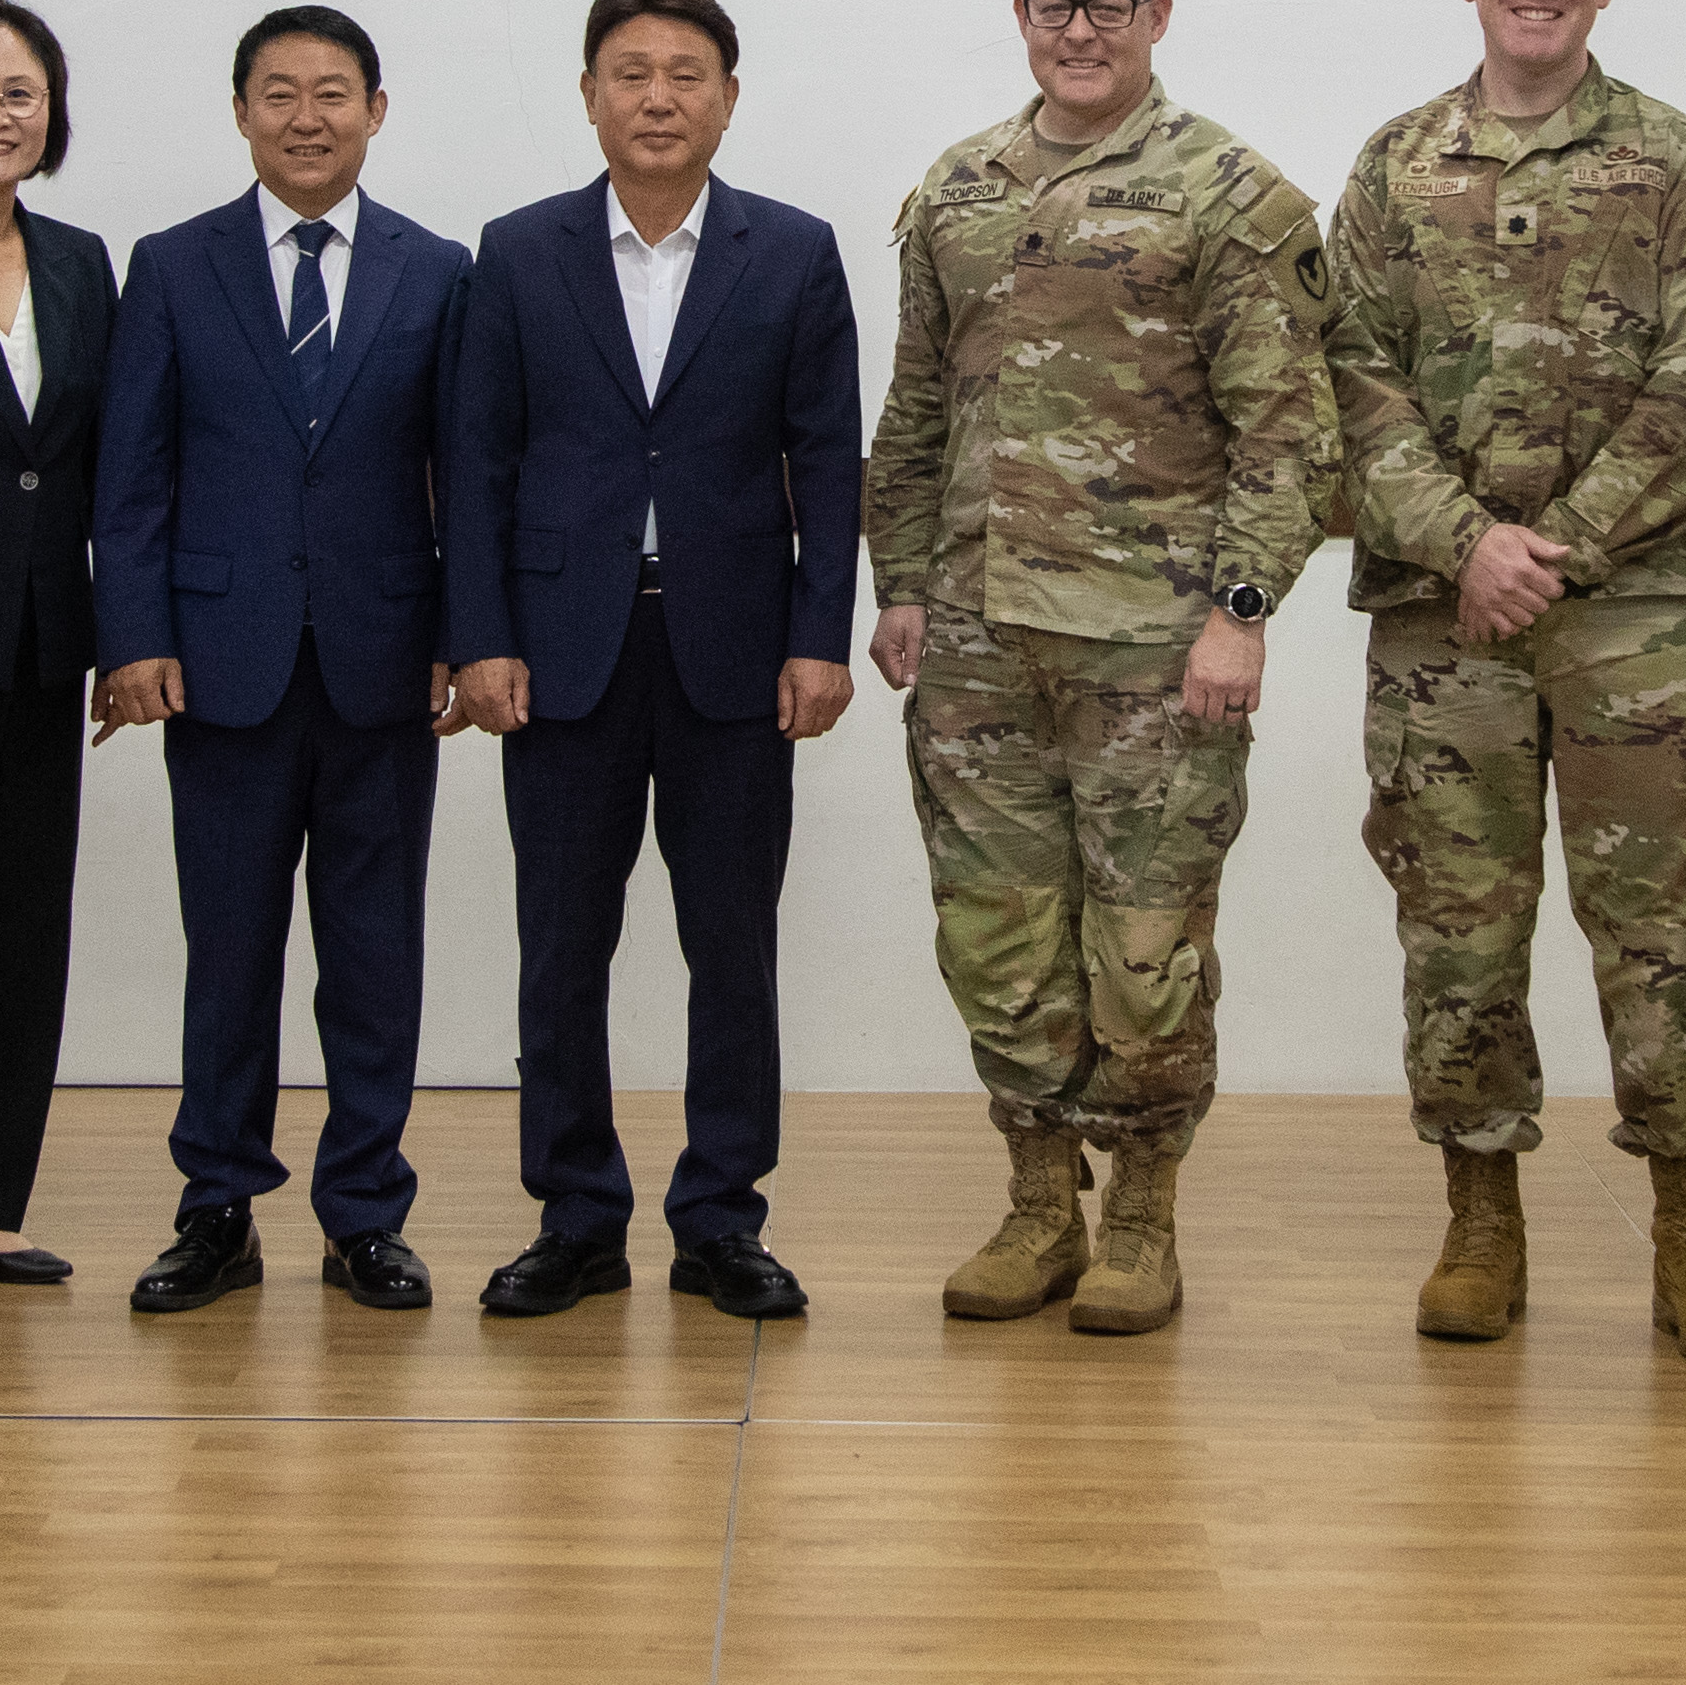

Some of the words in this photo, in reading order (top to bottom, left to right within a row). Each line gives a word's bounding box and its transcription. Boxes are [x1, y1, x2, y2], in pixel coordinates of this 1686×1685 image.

[1607, 169, 1627, 183] AIR
[940, 182, 998, 202] THOMPSON
[1126, 191, 1165, 206] ARMY
